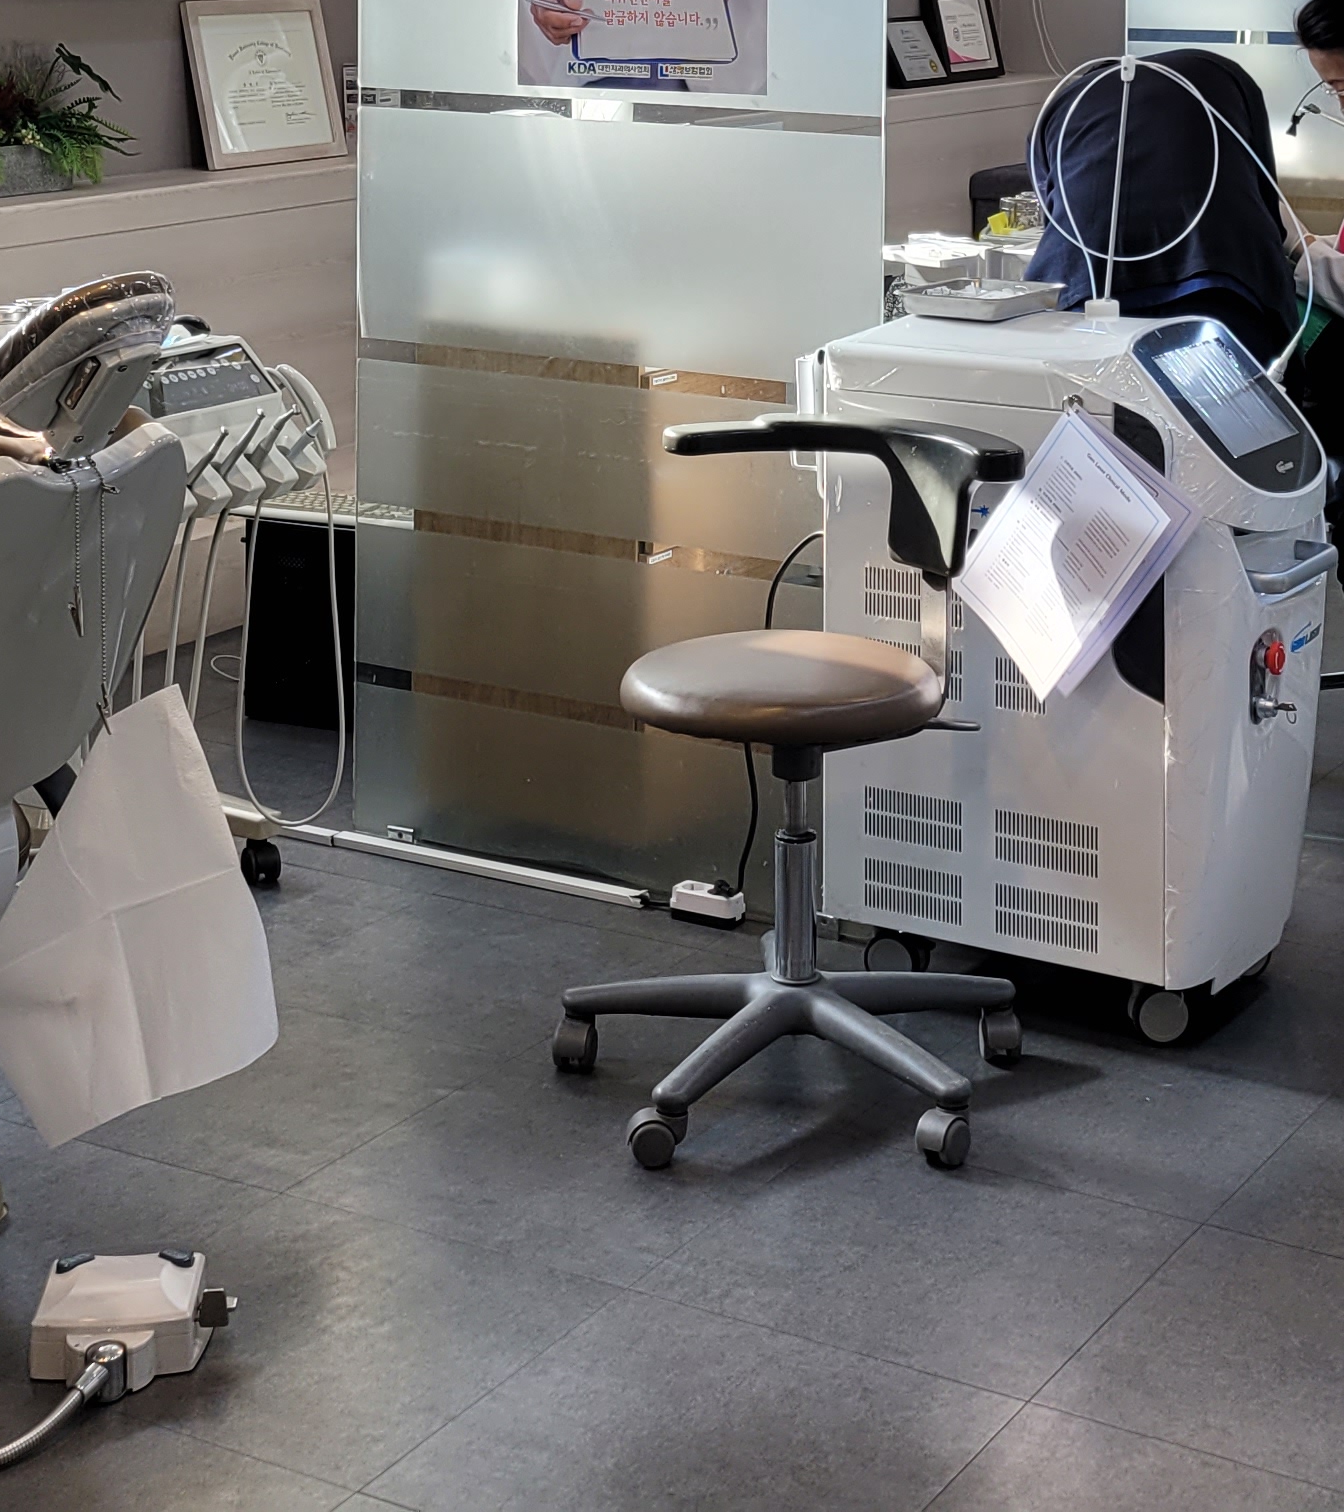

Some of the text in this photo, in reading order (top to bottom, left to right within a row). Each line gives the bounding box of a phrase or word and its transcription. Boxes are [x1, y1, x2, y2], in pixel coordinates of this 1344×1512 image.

[604, 9, 704, 28] 발급하지 않습니다.
[568, 62, 596, 74] KDA
